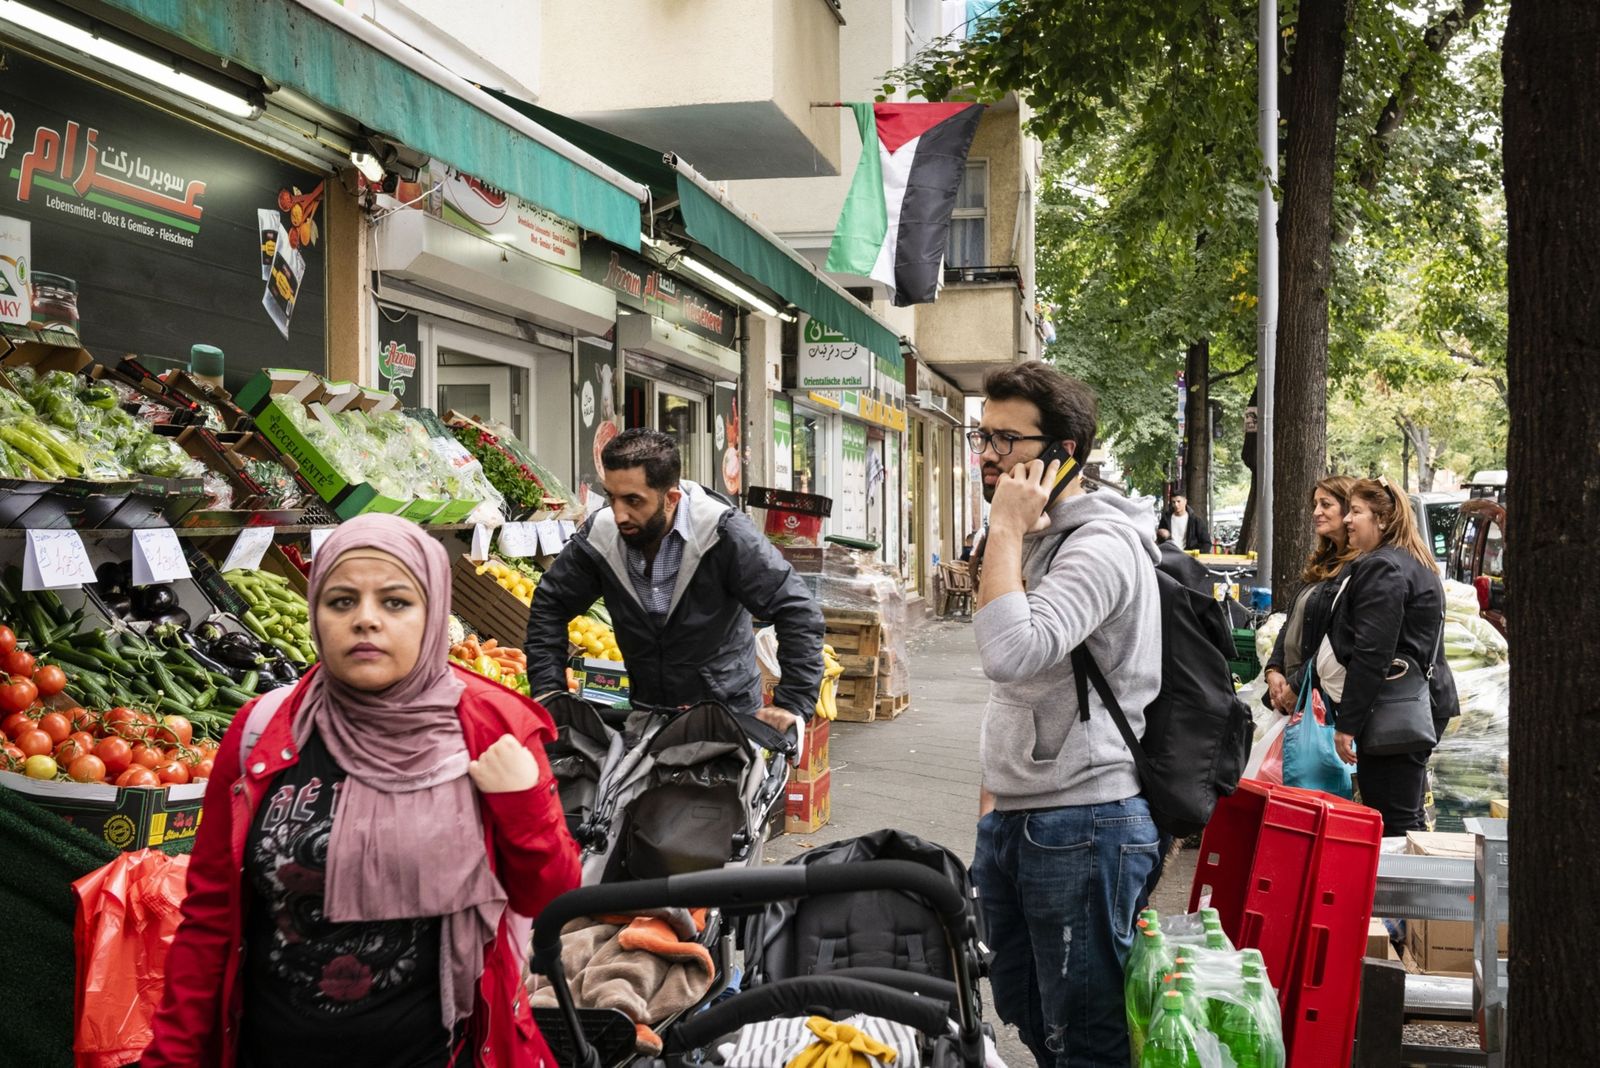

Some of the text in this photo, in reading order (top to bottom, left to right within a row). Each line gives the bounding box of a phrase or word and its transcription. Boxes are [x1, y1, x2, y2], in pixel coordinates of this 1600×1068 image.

[17, 120, 206, 221] عزام
[101, 146, 184, 192] سوبرماركت
[46, 195, 96, 220] Lebensmittel
[102, 211, 119, 227] Obst
[121, 218, 126, 229] &
[127, 219, 154, 237] Gemüse
[159, 228, 194, 248] Fleischerei
[804, 376, 862, 386] Orientalische Artikel
[269, 421, 328, 487] ECCELLENTE
